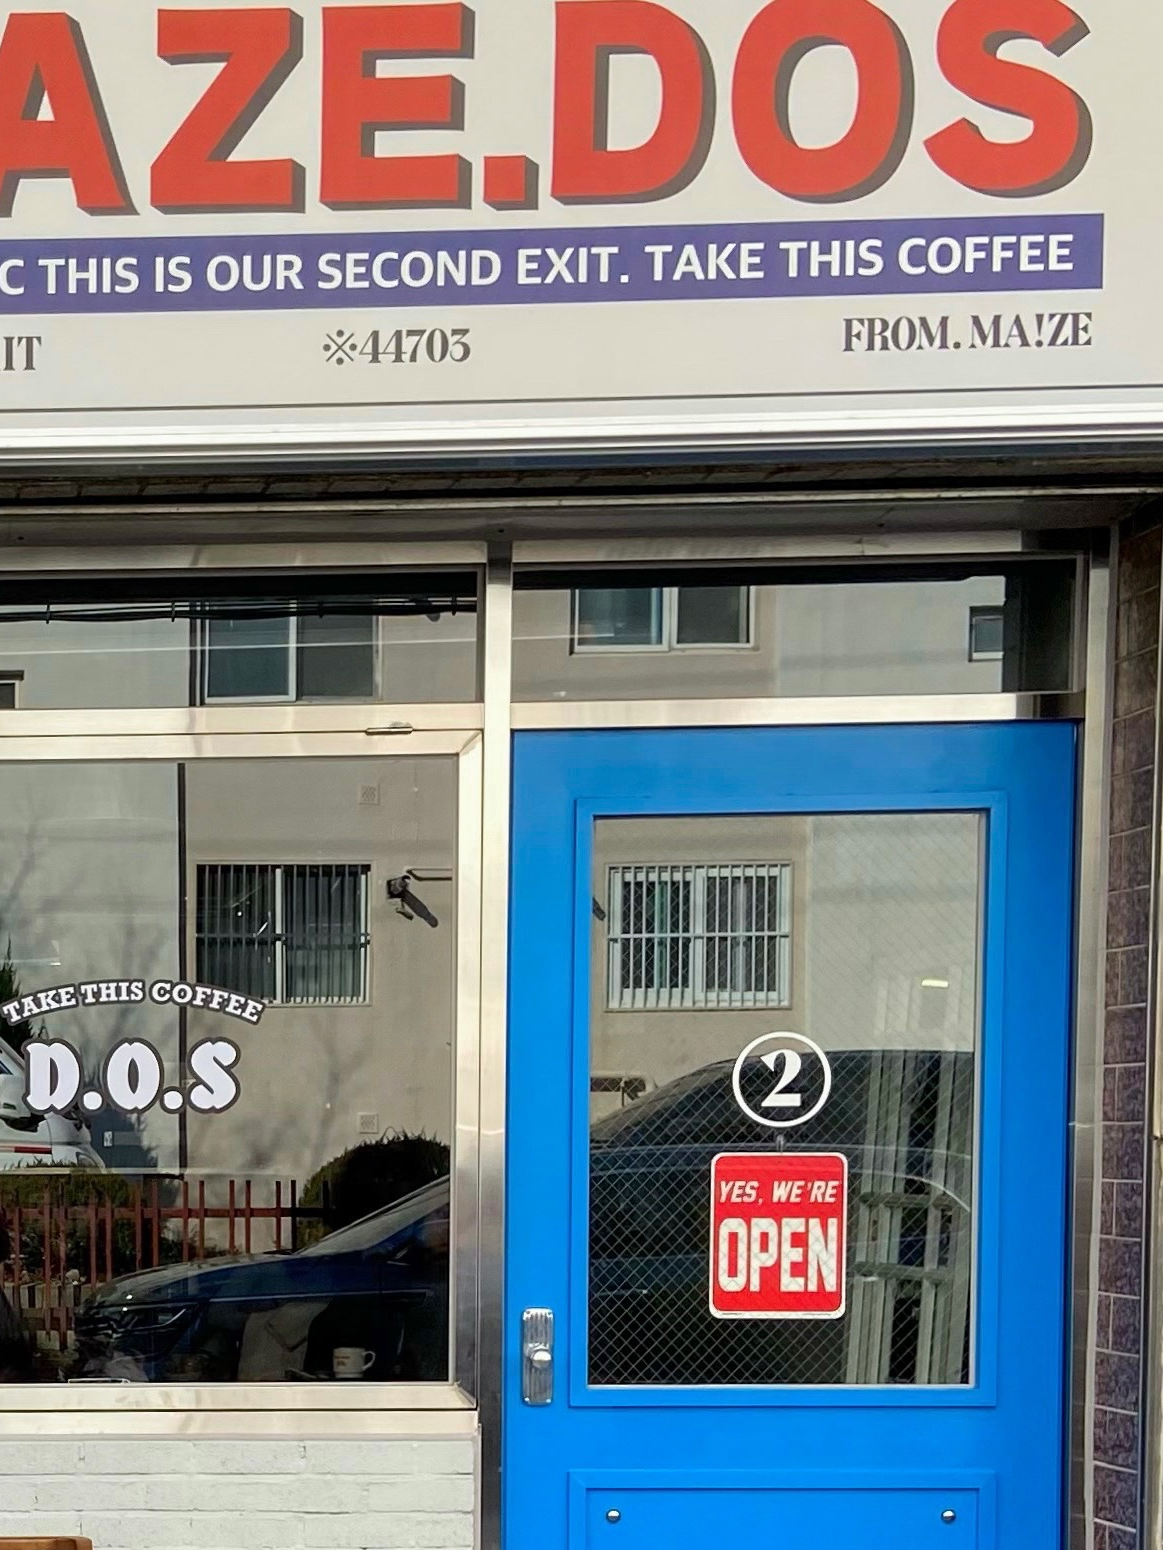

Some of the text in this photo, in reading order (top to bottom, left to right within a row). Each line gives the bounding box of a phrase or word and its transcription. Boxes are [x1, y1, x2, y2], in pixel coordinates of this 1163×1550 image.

[37, 255, 139, 296] THIS
[154, 254, 193, 293] IS
[205, 252, 304, 292] OUR
[317, 249, 502, 291] SECOND
[517, 246, 630, 286] EXIT.
[644, 242, 765, 282] TAKE
[779, 238, 885, 279] THIS
[898, 233, 1075, 276] COFFEE
[842, 311, 1094, 354] FROM. MA!ZE
[2, 981, 264, 1023] TAKE THIS COFFEE
[25, 1040, 240, 1112] D.O.S
[718, 1180, 838, 1205] YES, WE'RE
[717, 1217, 838, 1293] OPEN
